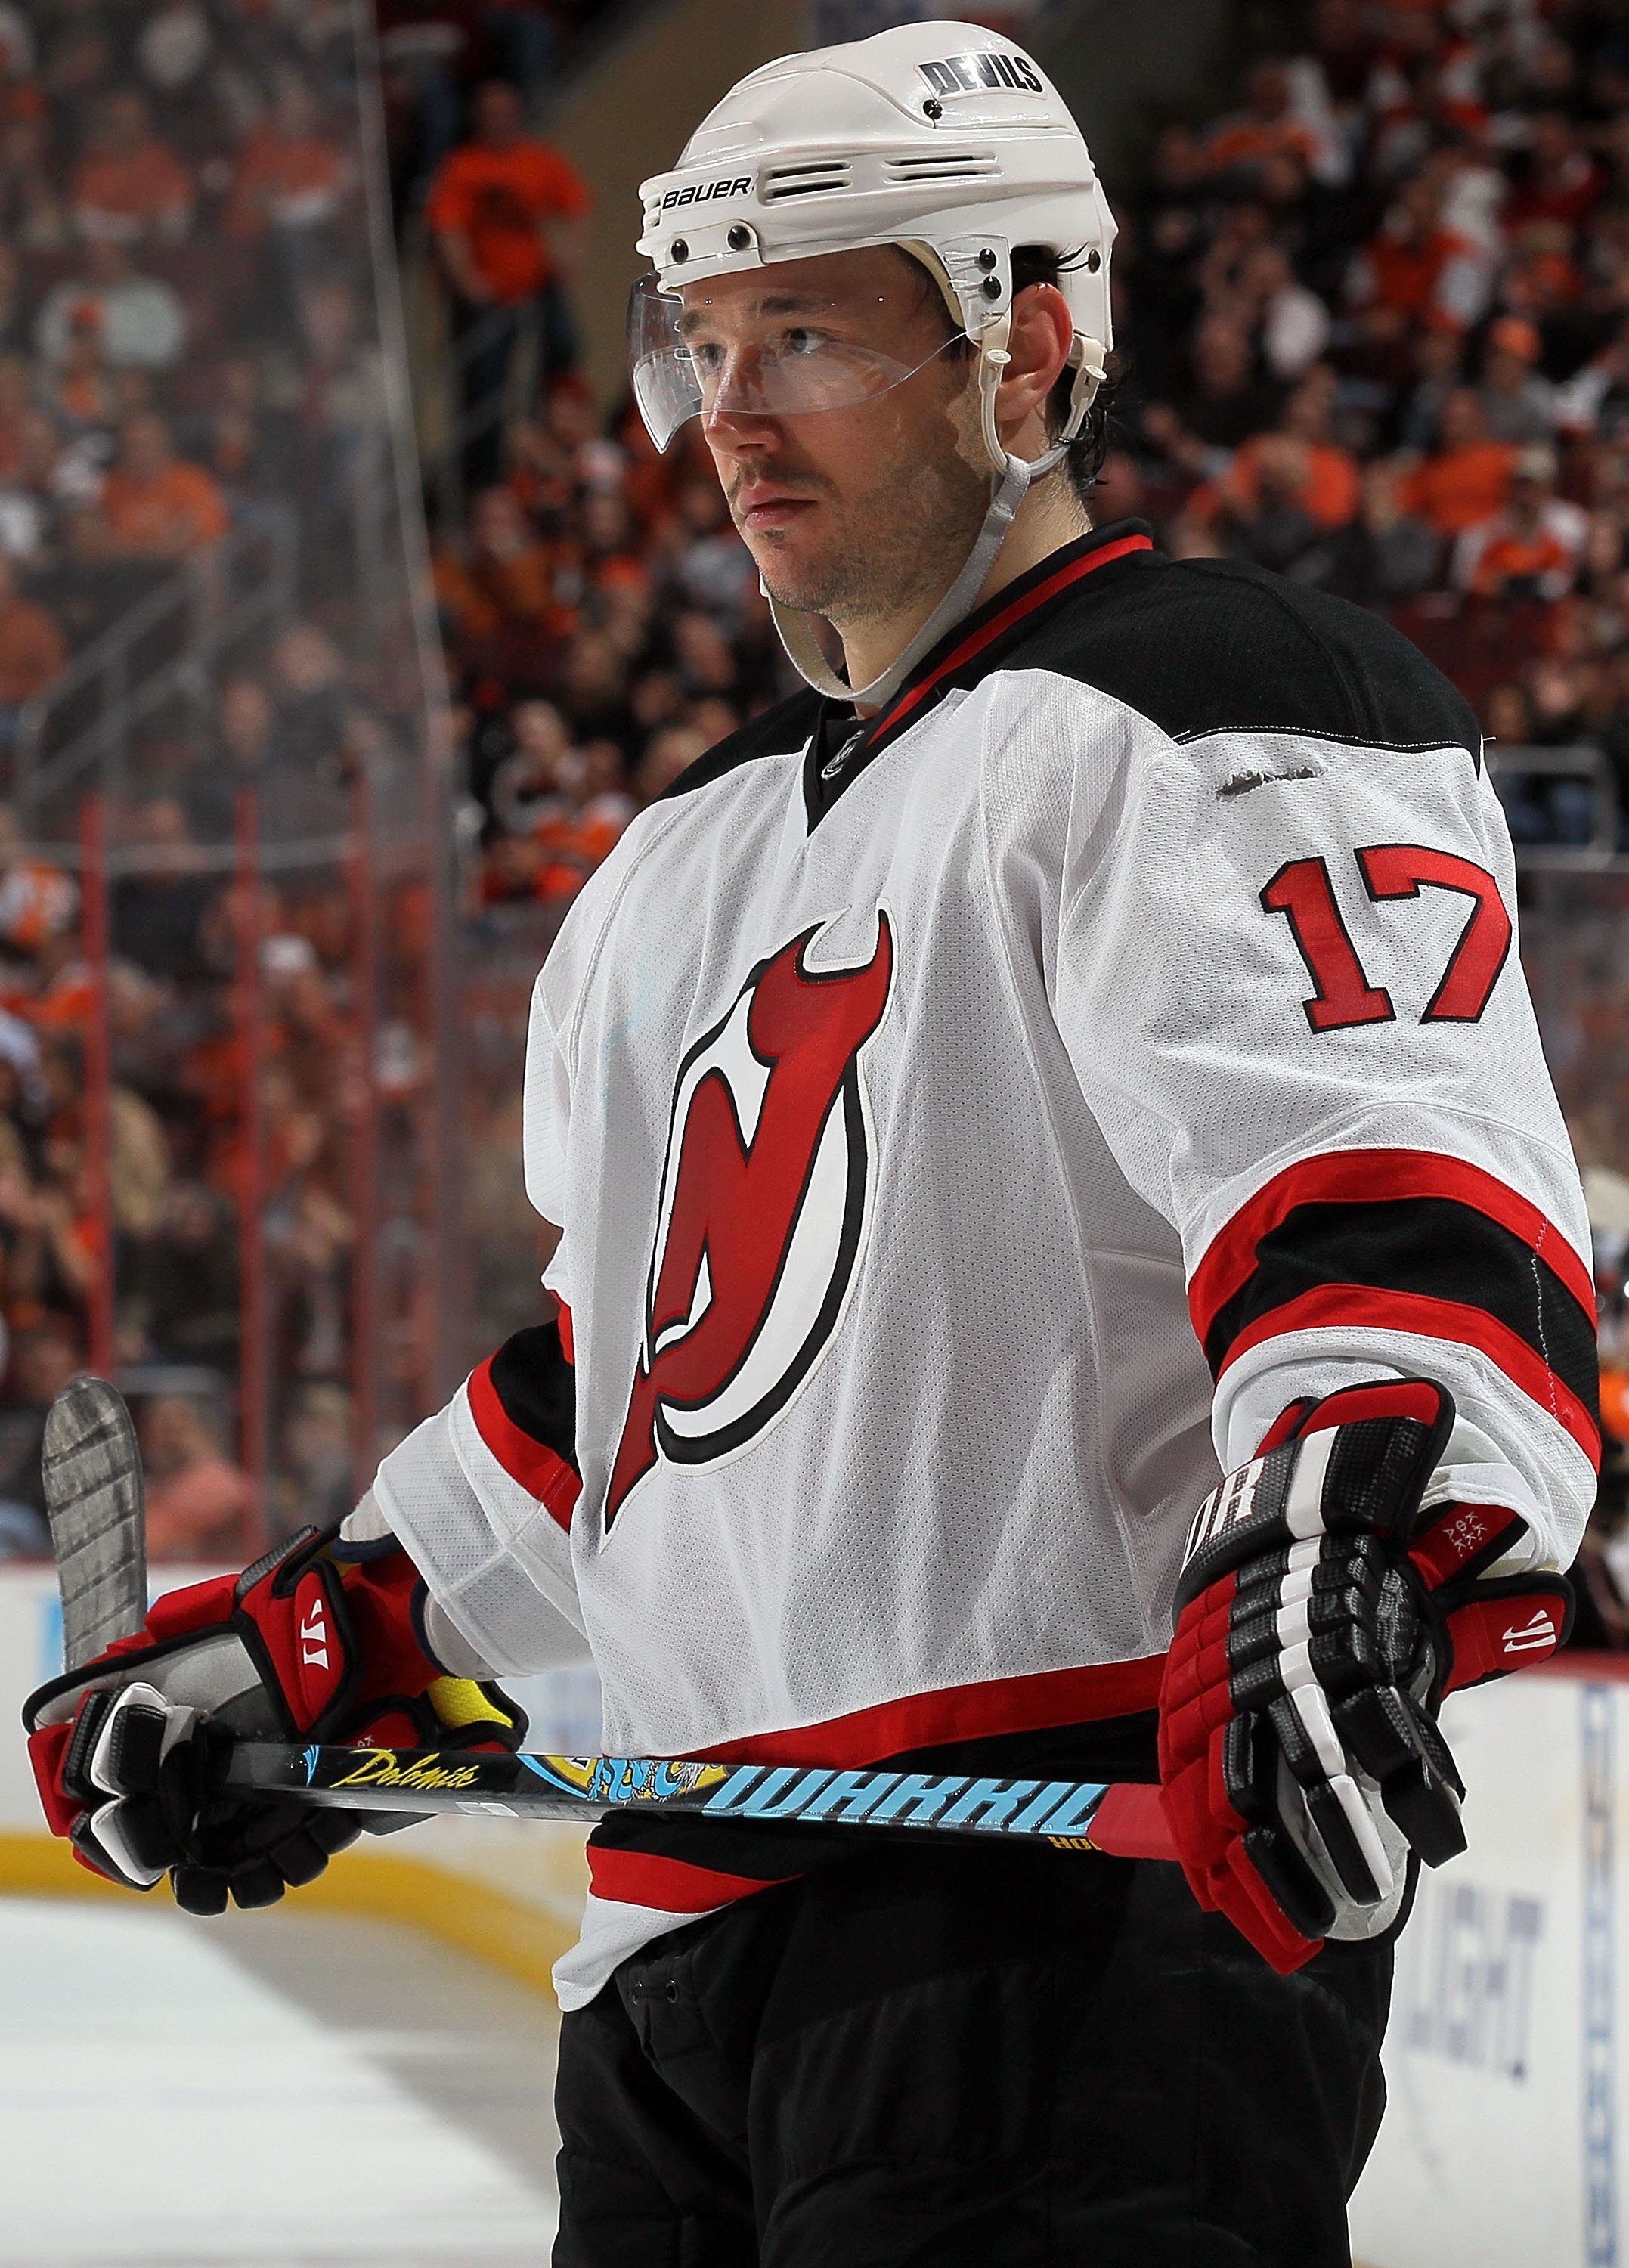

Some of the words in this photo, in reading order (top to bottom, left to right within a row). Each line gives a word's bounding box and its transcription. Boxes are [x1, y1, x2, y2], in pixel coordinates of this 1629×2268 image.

[918, 54, 1043, 96] DEVILS
[662, 177, 752, 210] BAUER
[1259, 844, 1513, 1035] 17
[329, 1747, 482, 1790] Dolomite
